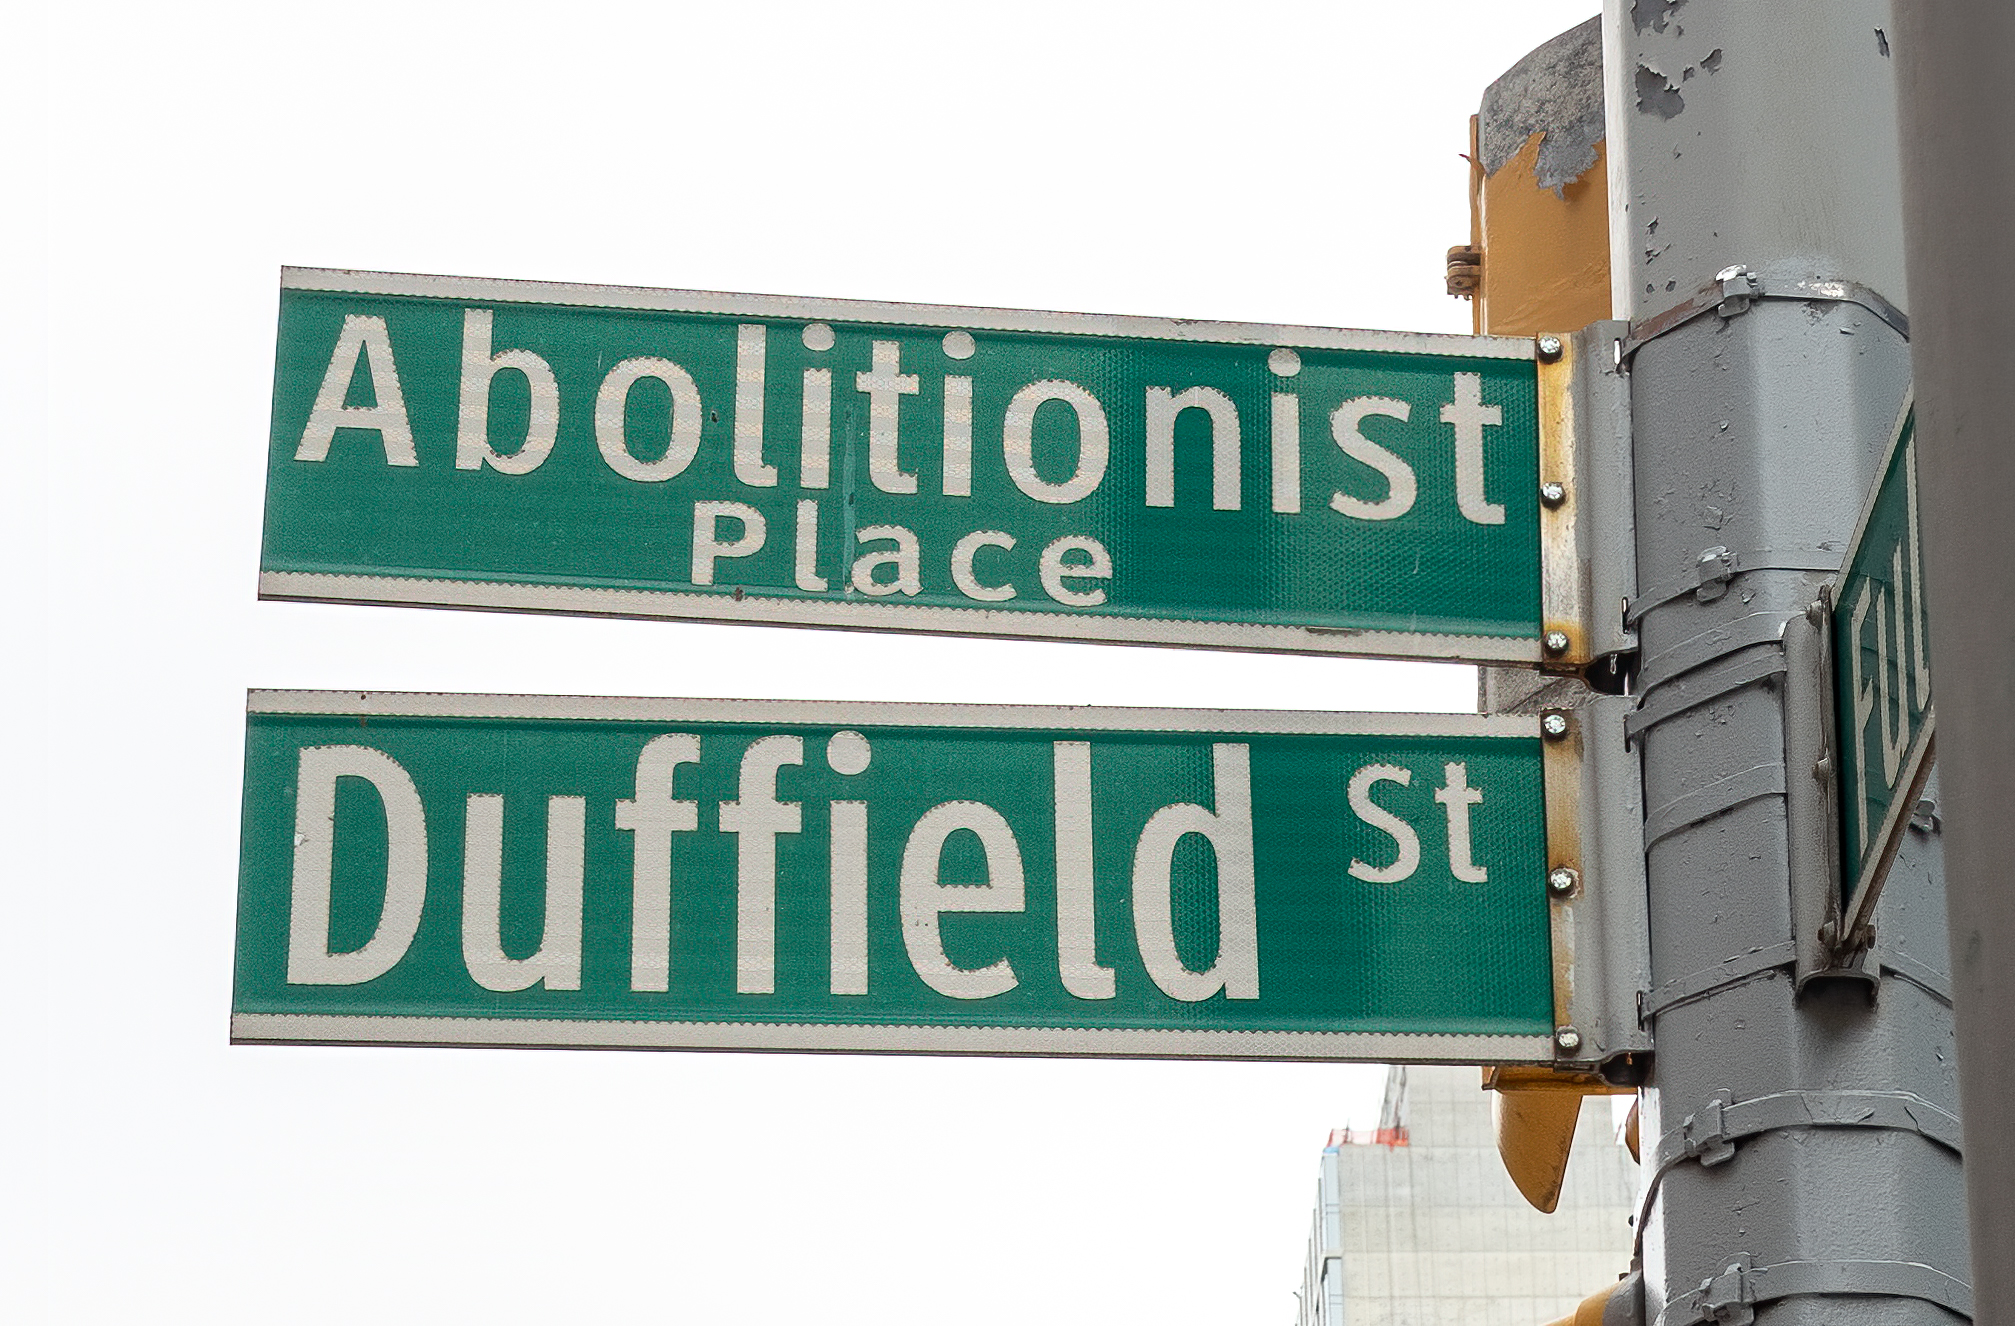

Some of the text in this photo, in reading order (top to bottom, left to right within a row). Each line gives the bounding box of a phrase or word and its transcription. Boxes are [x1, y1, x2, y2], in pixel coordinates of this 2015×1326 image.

[294, 308, 1506, 525] Abolitionist
[691, 498, 1113, 607] Place
[1851, 430, 1931, 861] Ful
[287, 731, 1488, 1002] Duffield St
